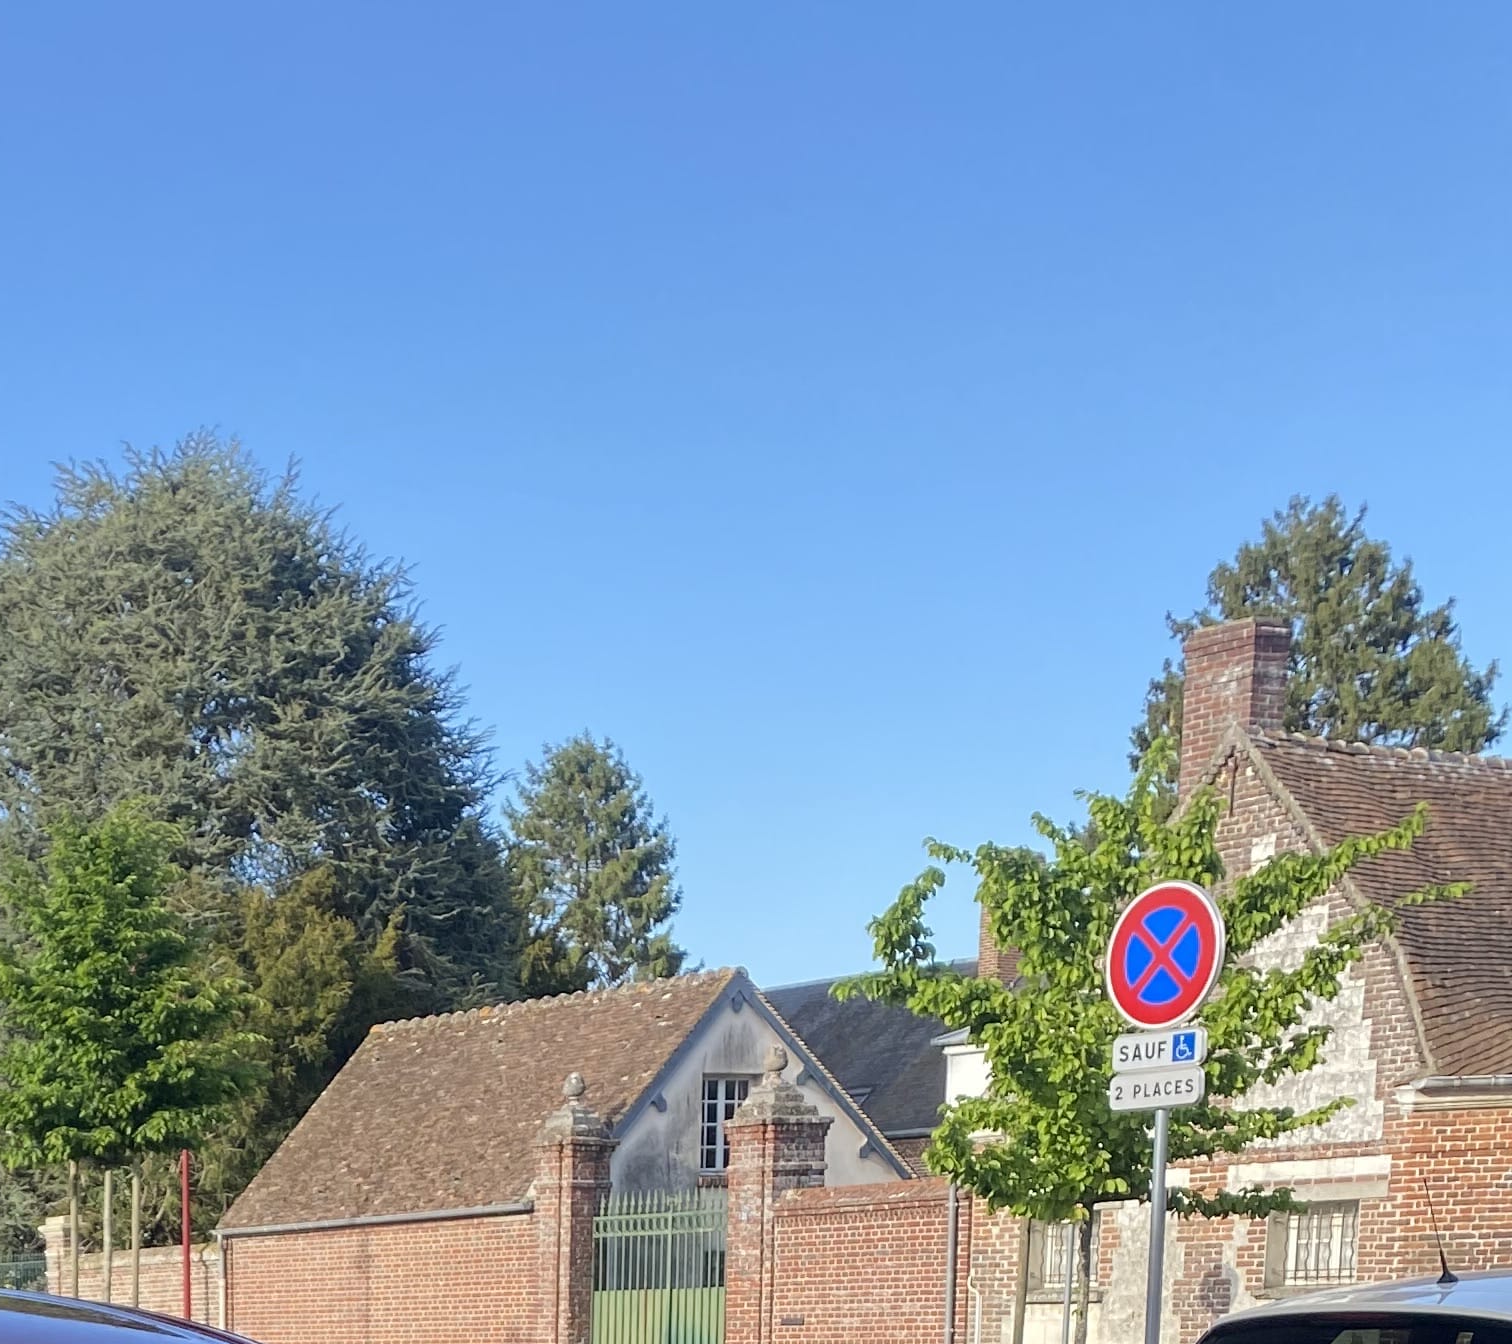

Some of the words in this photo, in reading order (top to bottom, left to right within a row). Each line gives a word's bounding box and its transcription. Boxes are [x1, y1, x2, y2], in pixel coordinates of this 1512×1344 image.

[1119, 1040, 1168, 1062] SAUF
[1115, 1086, 1124, 1100] 2
[1133, 1078, 1194, 1098] PLACES
